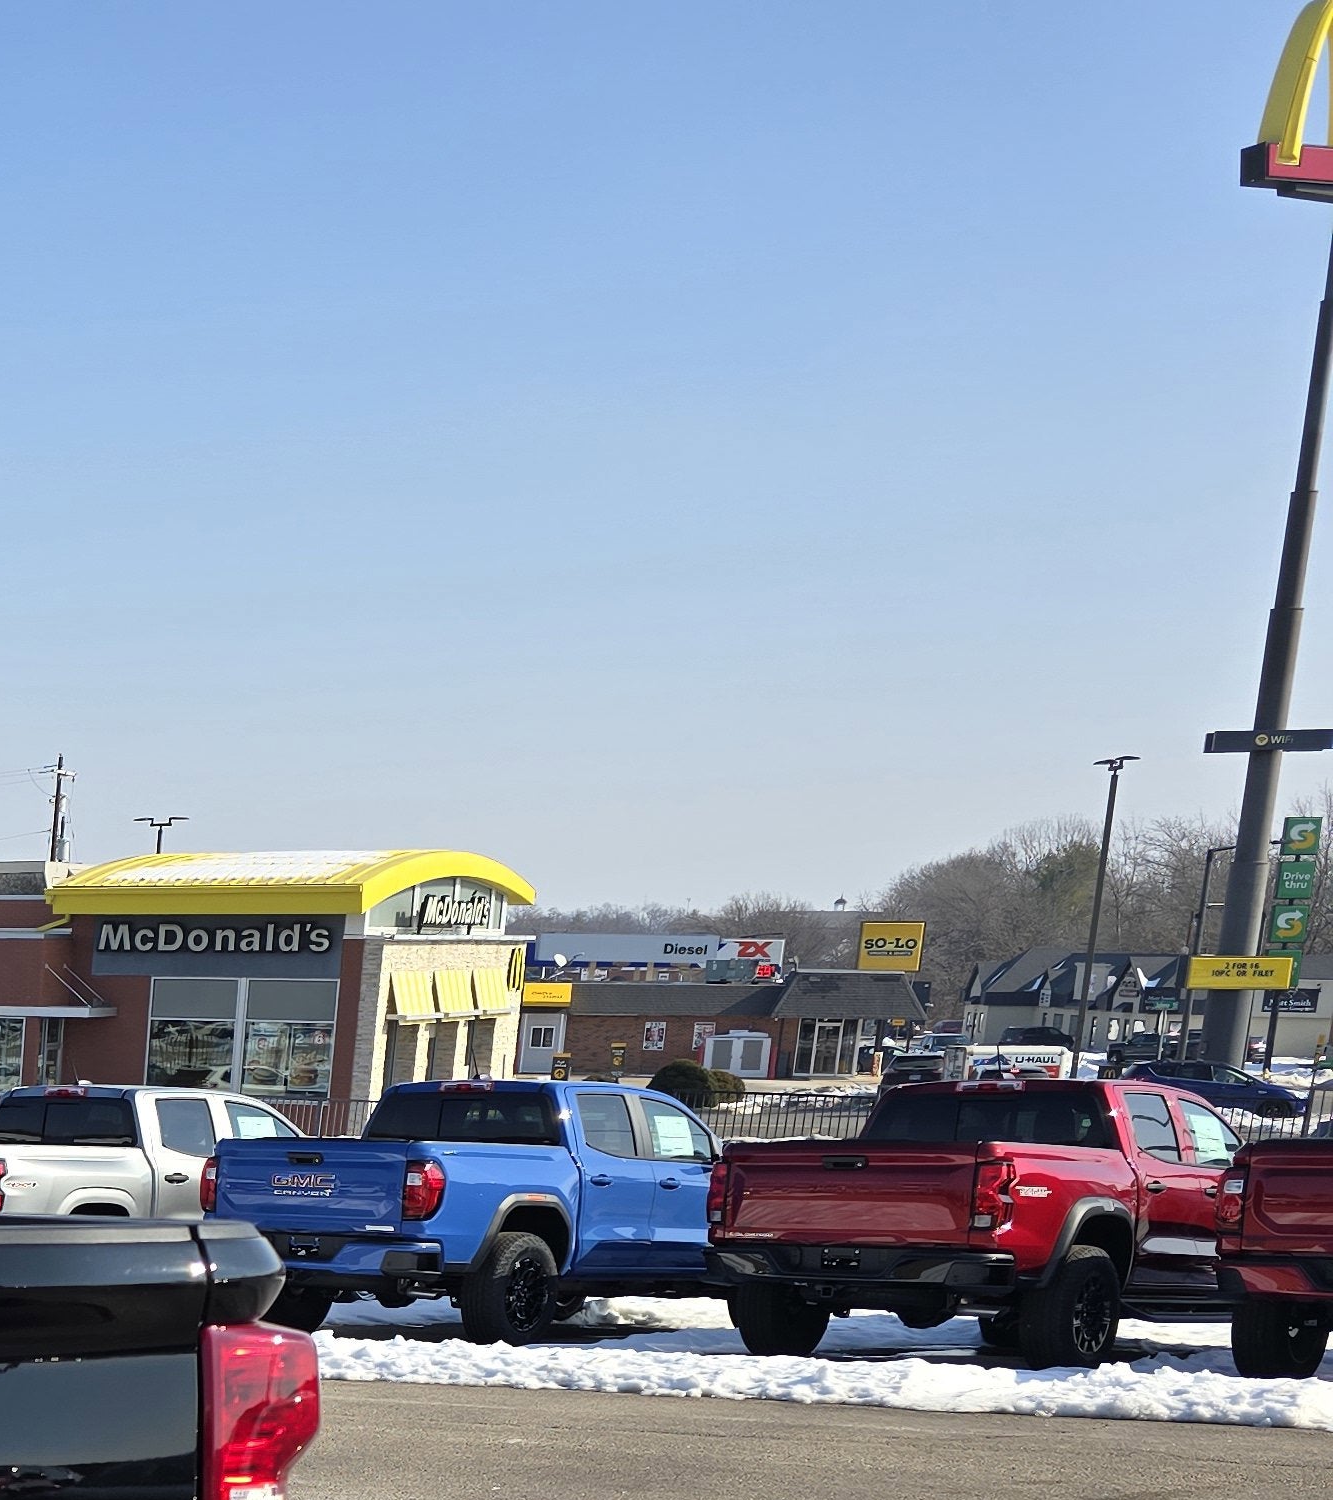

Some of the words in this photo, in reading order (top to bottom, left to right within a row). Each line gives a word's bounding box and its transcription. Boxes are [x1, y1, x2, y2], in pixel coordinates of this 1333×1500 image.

[1282, 871, 1311, 881] Drive
[1284, 880, 1308, 889] thru
[422, 896, 491, 926] McDonald's
[97, 923, 331, 952] McDonald's
[864, 937, 918, 949] SO-LO
[663, 943, 708, 955] Diesel
[1224, 962, 1231, 970] 2
[1232, 962, 1248, 970] FOR
[1015, 1056, 1057, 1064] U-HAUL
[271, 1173, 337, 1189] GMC
